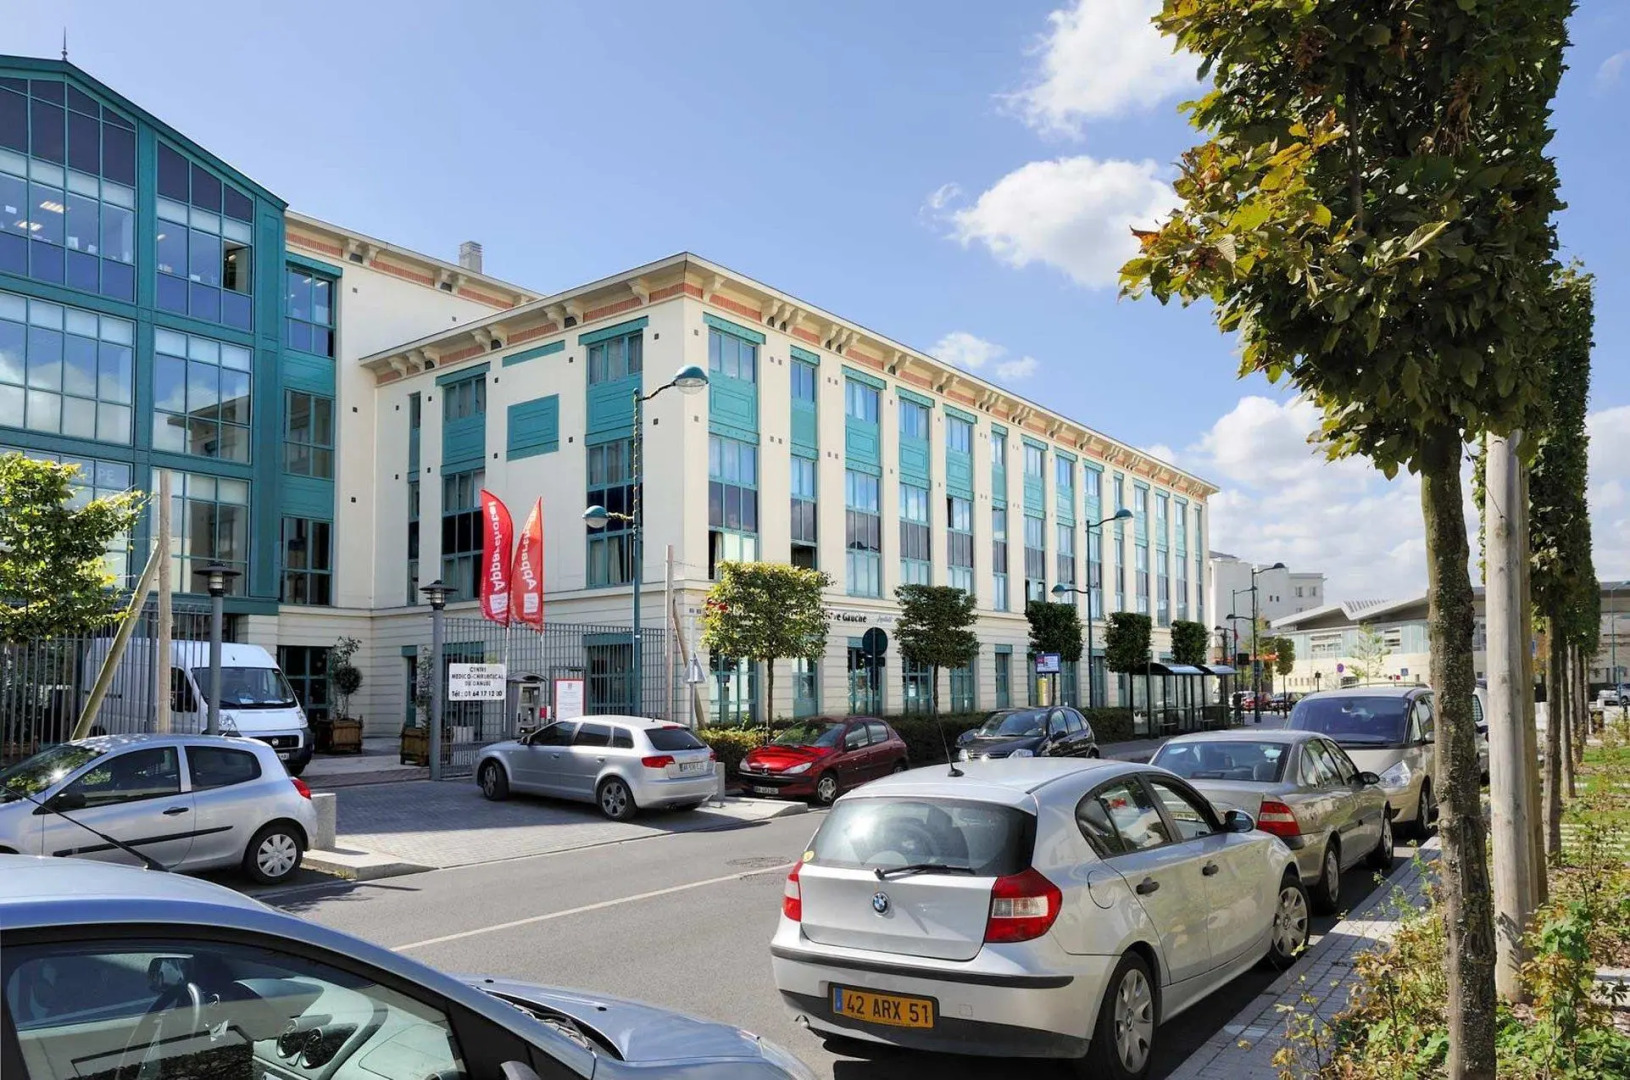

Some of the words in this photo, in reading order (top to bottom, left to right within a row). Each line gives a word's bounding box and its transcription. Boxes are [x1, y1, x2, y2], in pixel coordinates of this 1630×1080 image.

[842, 612, 867, 623] Gauche
[846, 994, 865, 1015] 42
[872, 998, 902, 1020] ARX
[909, 1002, 929, 1024] 51
